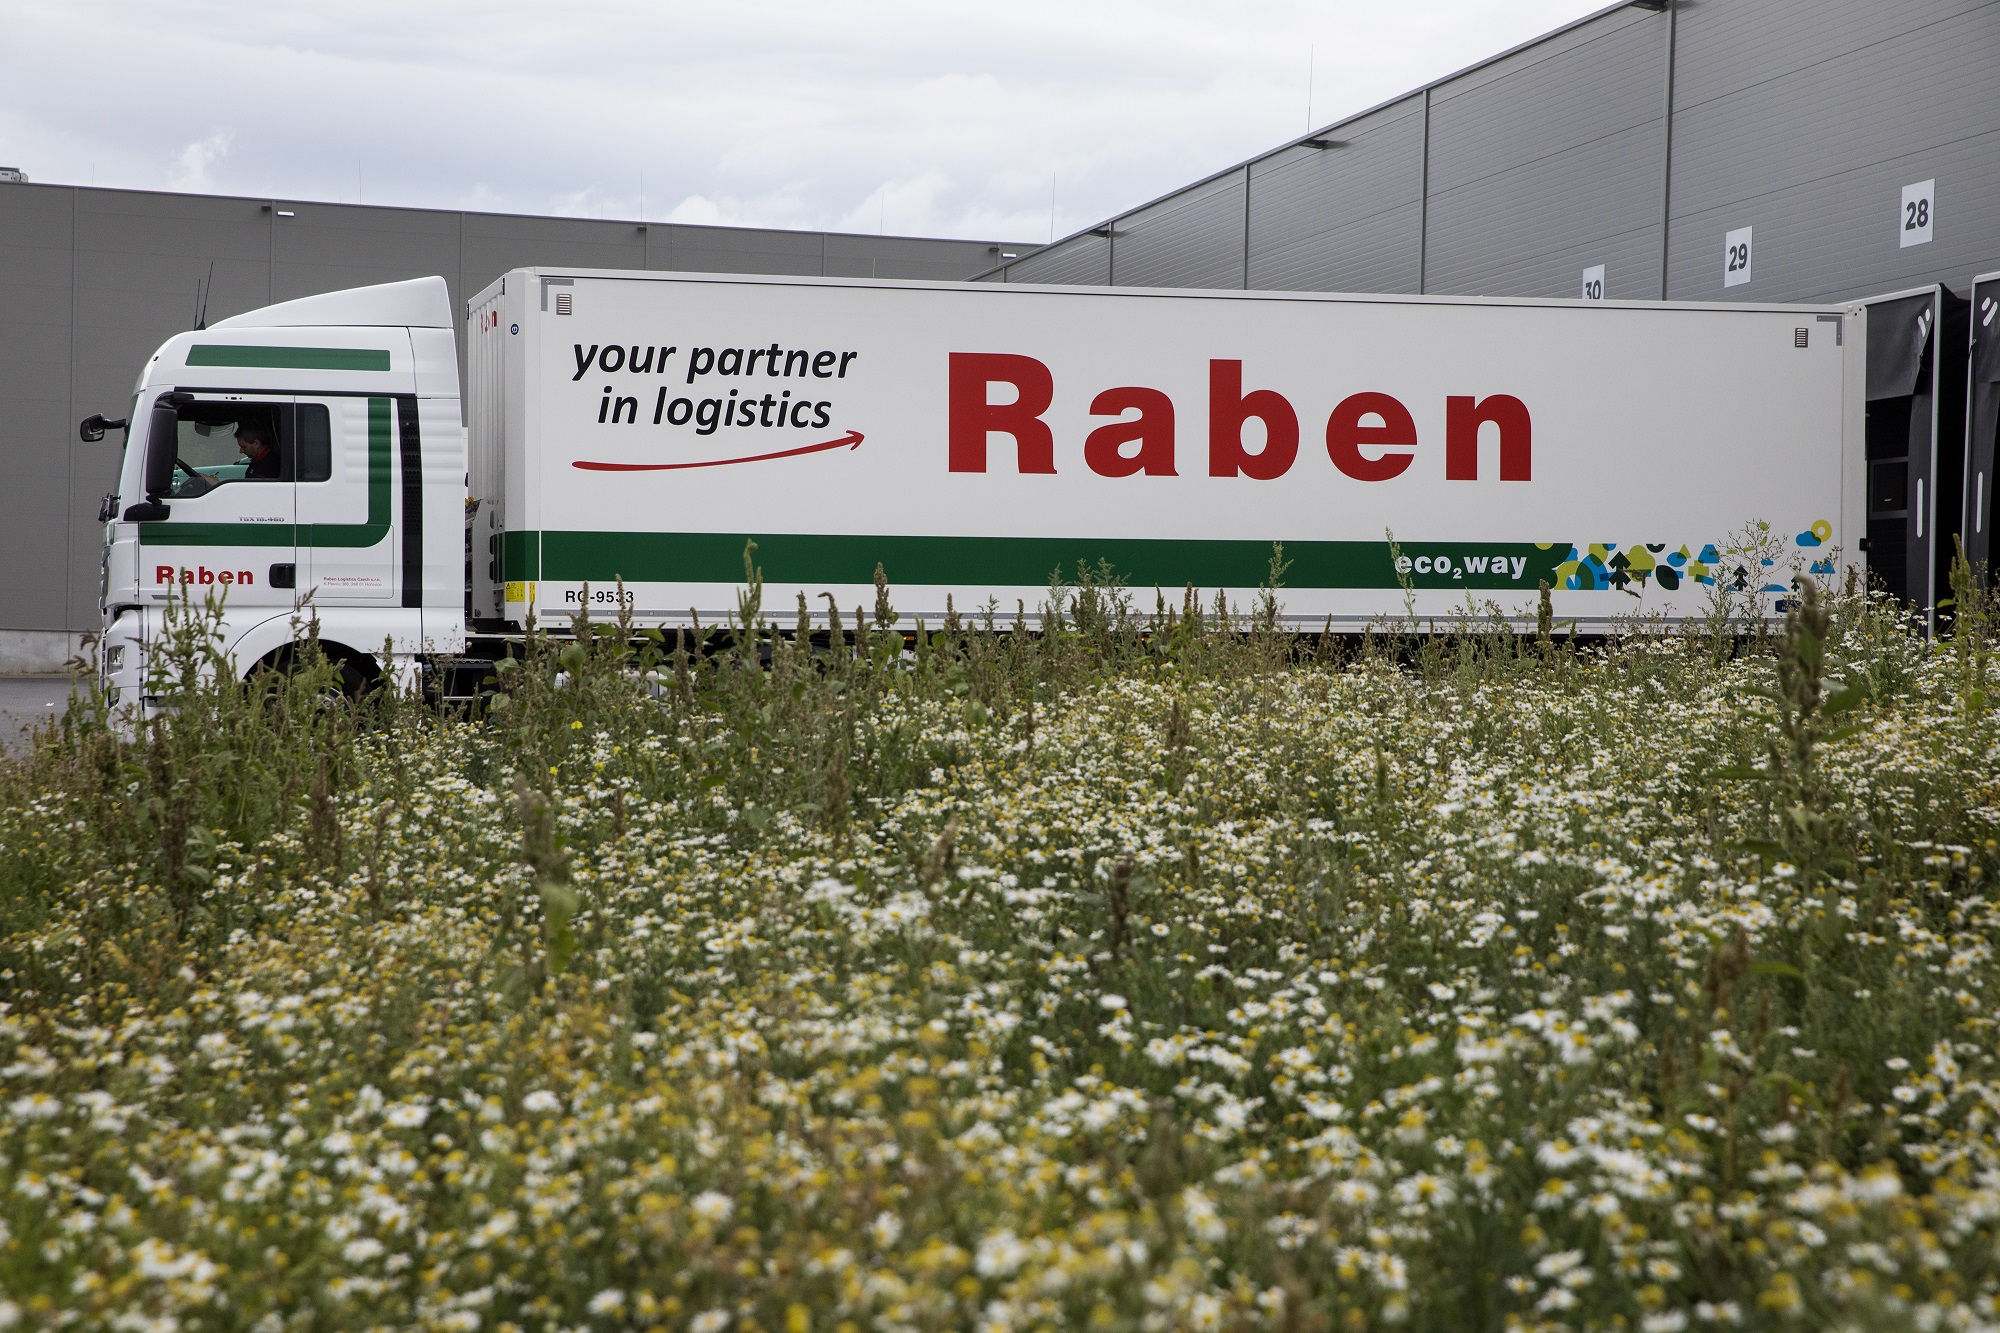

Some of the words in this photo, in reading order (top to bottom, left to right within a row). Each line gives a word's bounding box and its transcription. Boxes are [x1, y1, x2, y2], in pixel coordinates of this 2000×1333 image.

[1904, 198, 1930, 232] 28
[1728, 243, 1749, 273] 29
[1585, 279, 1602, 300] 30
[571, 343, 677, 381] your
[686, 343, 858, 384] partner
[597, 385, 638, 424] in
[653, 386, 832, 435] logistics
[948, 352, 1532, 483] Raben
[156, 565, 254, 585] Raben
